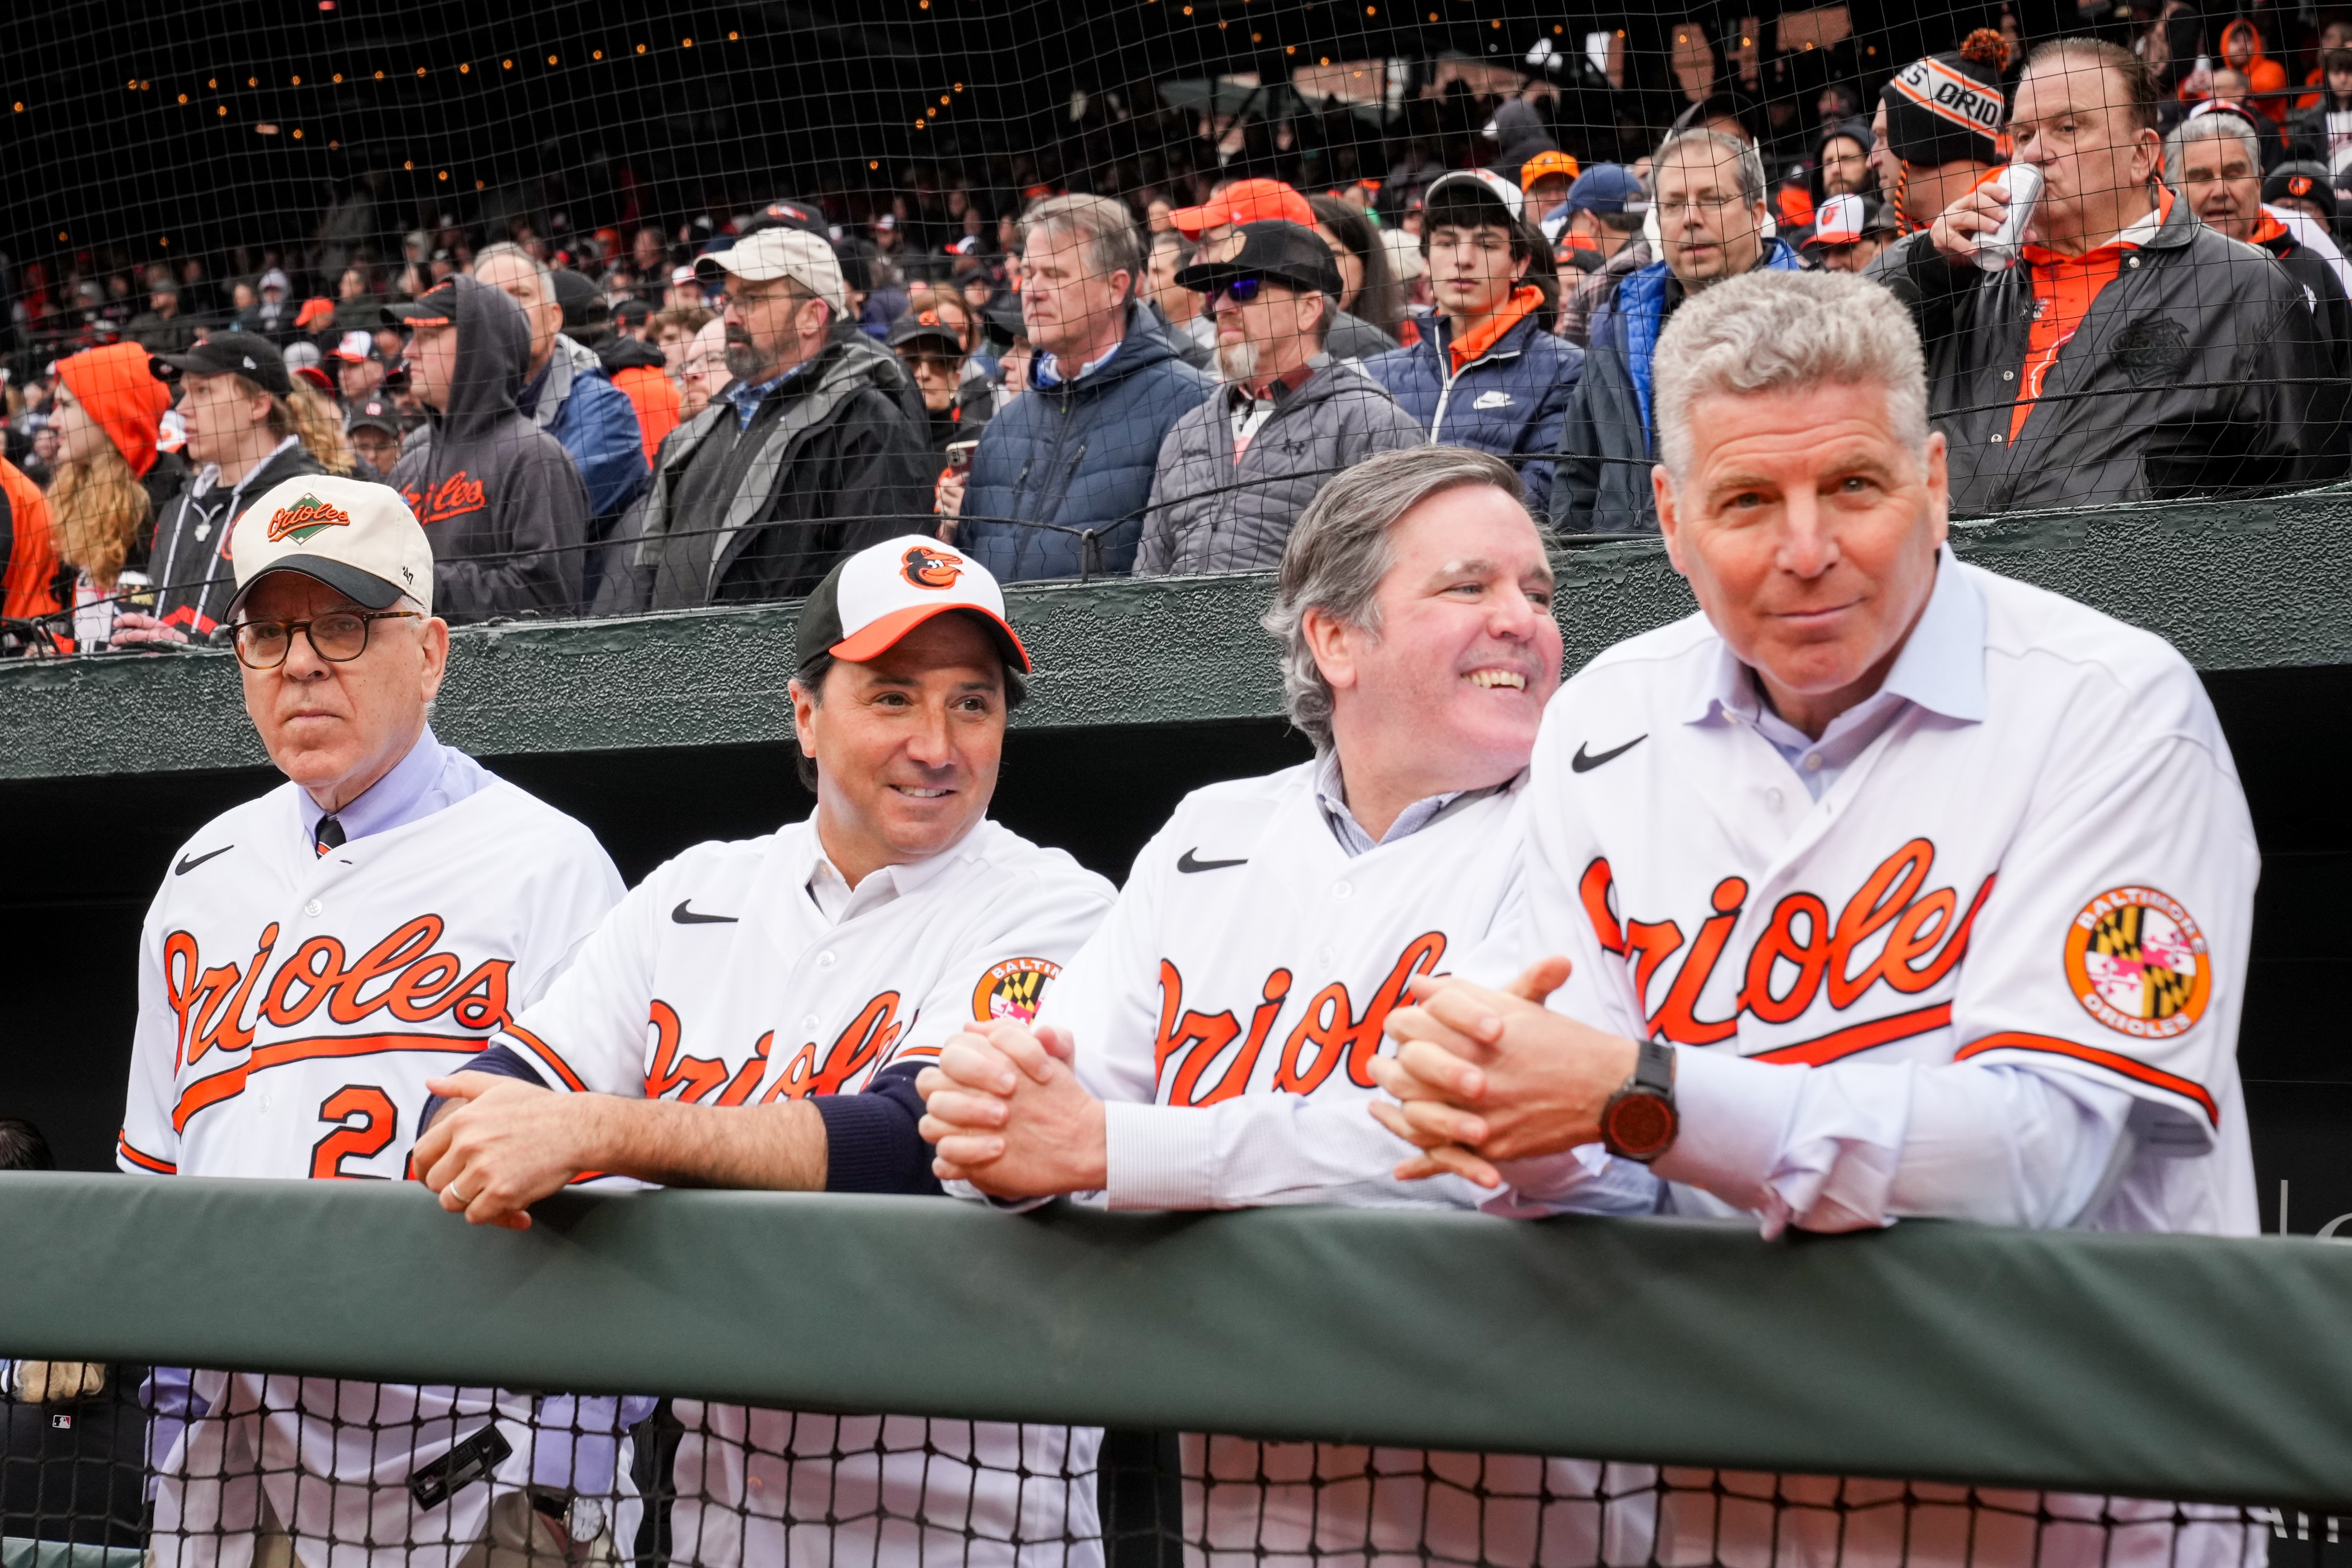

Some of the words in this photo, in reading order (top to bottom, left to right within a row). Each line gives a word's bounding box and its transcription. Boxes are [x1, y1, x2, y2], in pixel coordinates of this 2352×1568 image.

[267, 502, 350, 543] Orioles
[2076, 888, 2207, 955] BALTIMORE
[164, 913, 515, 1080] Orioles
[2083, 993, 2191, 1038] ORIOLES
[308, 1084, 416, 1180] 2
